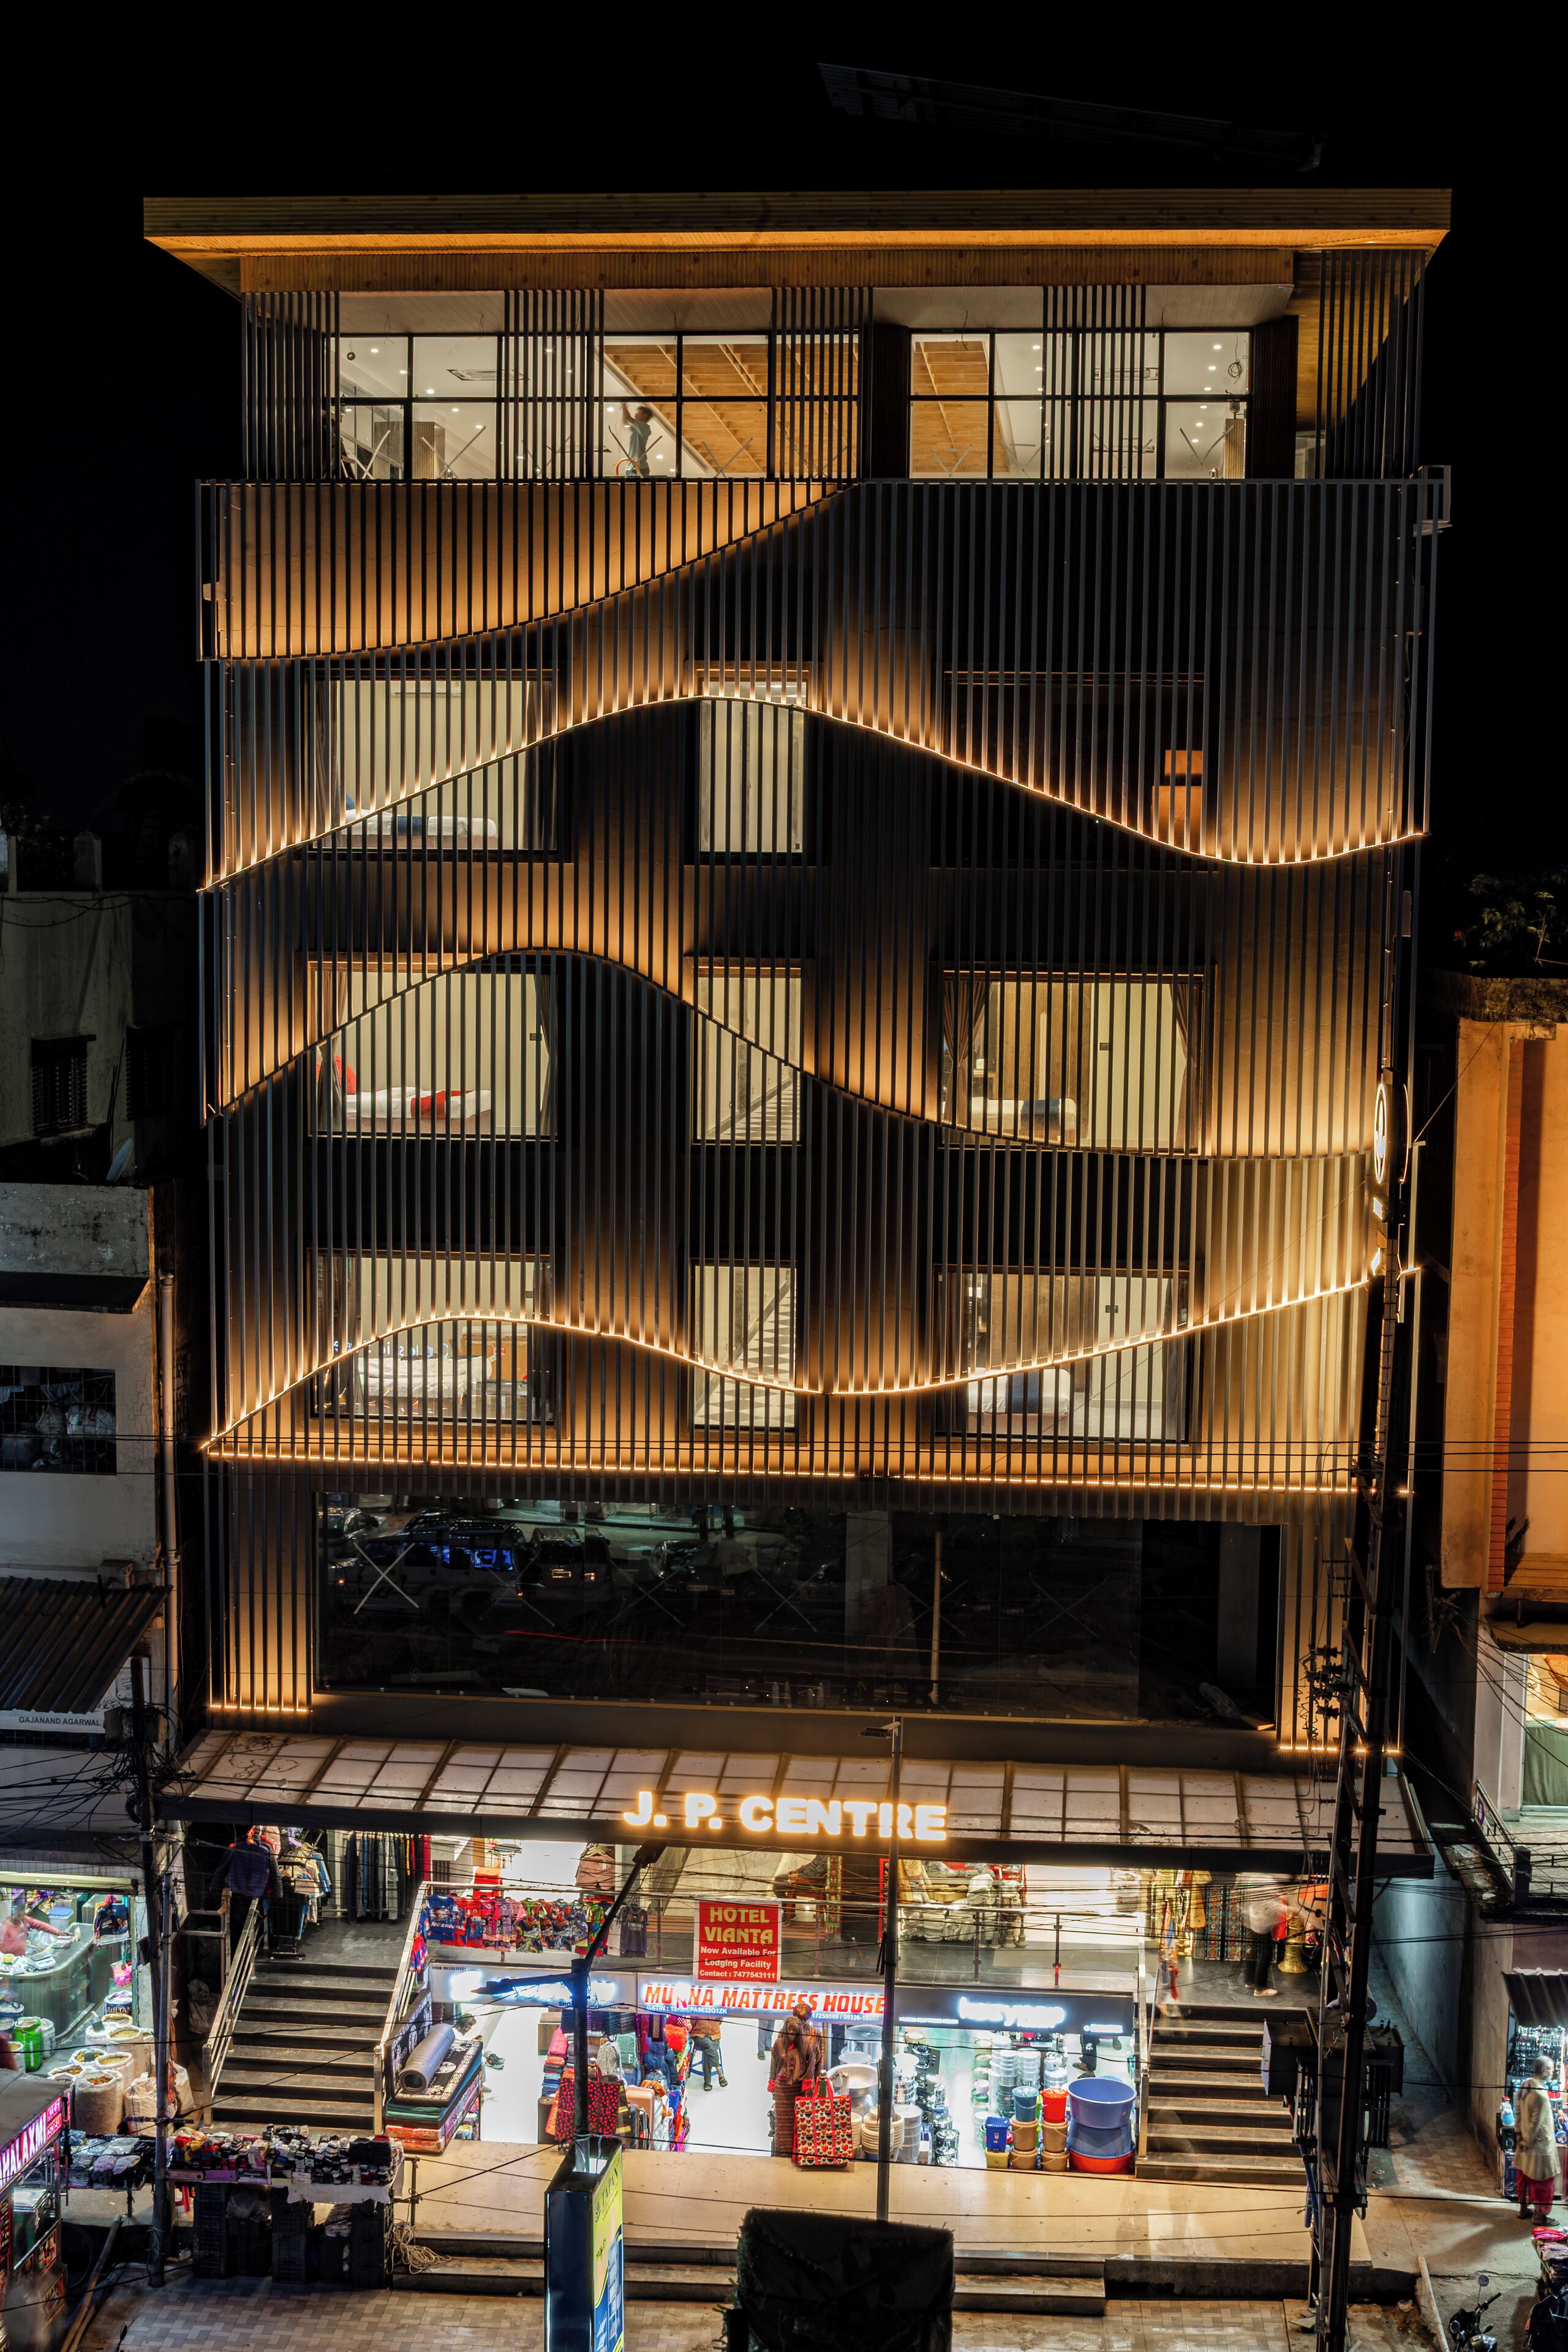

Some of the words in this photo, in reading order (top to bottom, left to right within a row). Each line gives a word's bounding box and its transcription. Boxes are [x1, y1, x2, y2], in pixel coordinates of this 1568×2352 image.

[739, 1796, 946, 1841] CENTRE
[710, 1907, 770, 1923] HOTEL
[704, 1926, 773, 1945] VIANTA
[722, 1947, 760, 1956] Available
[705, 1958, 738, 1969] Lodging
[741, 1960, 771, 1970] Facility
[721, 1990, 818, 2011] MATTRESS
[823, 1995, 885, 2014] HOUSE
[0, 2111, 47, 2188] HALAXMI
